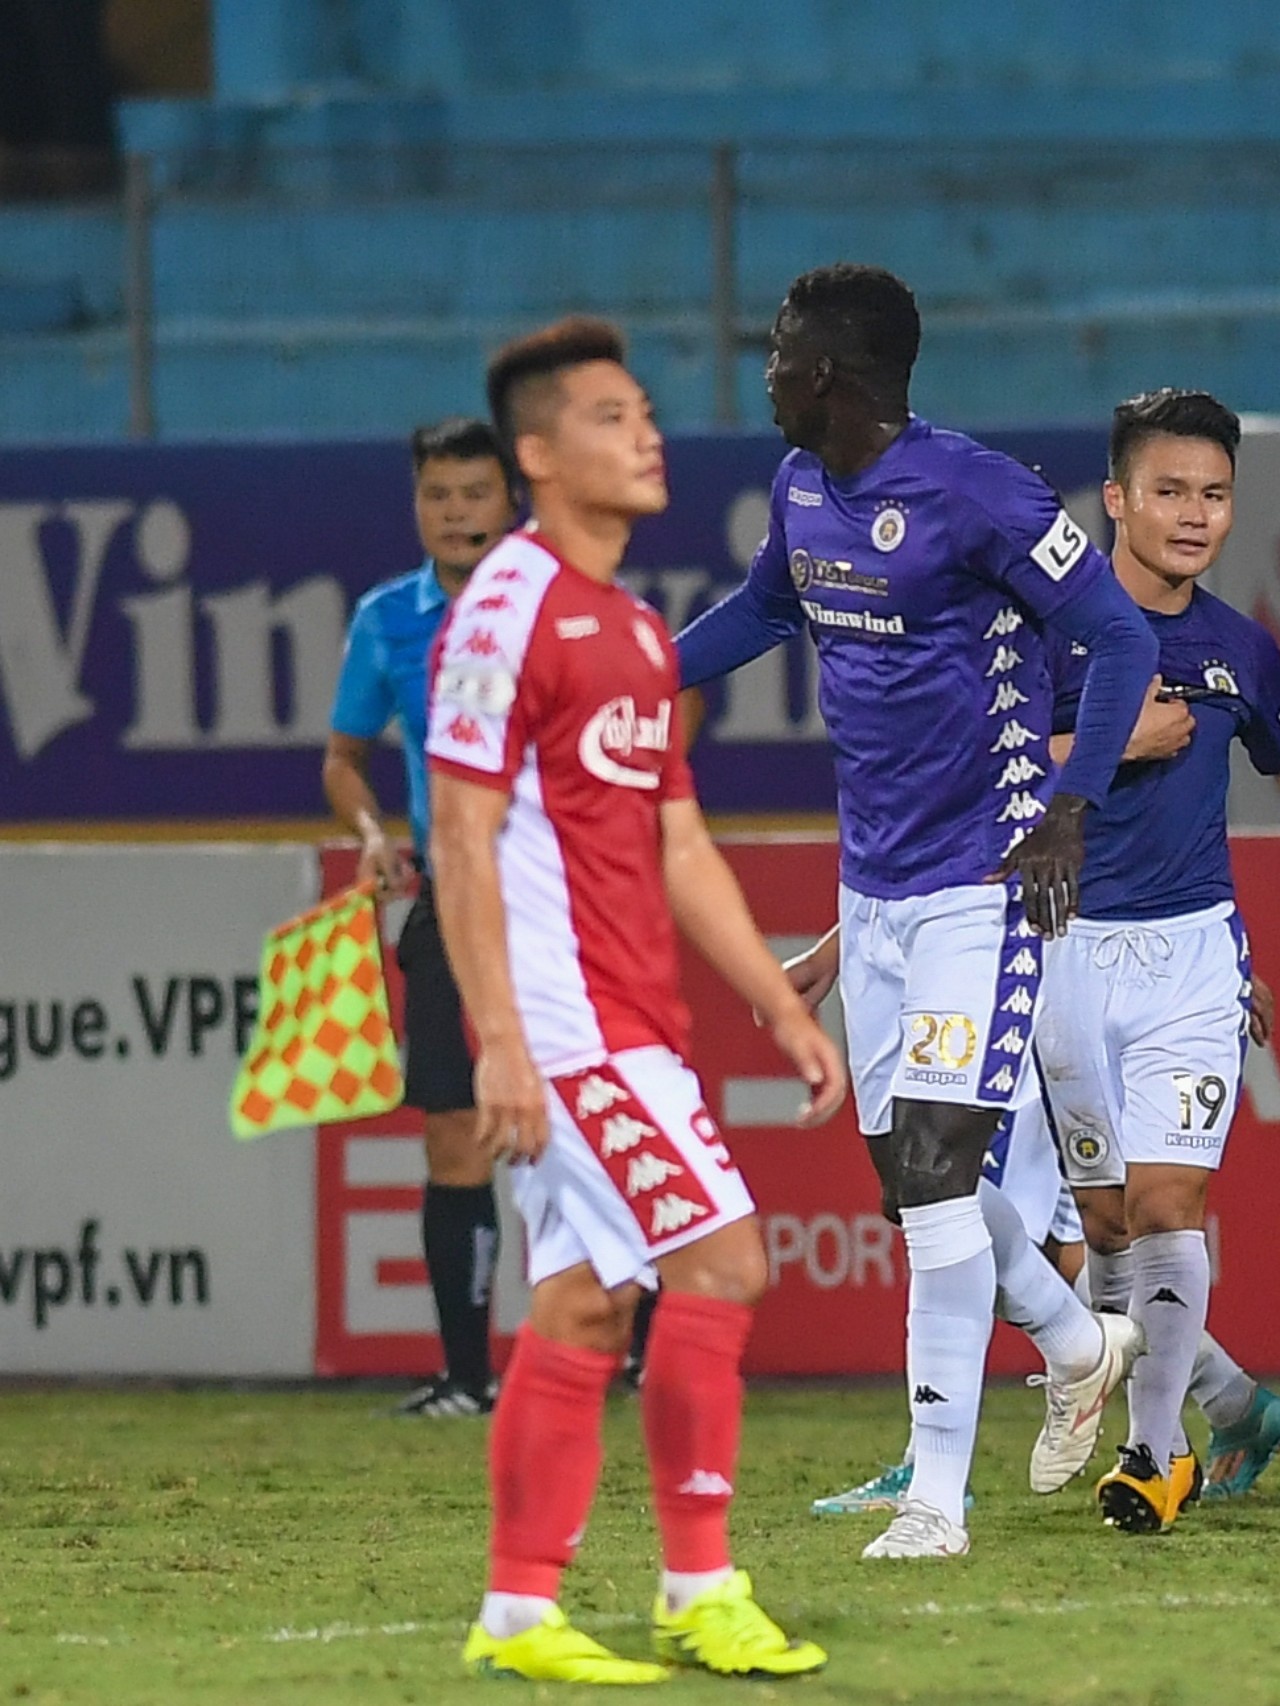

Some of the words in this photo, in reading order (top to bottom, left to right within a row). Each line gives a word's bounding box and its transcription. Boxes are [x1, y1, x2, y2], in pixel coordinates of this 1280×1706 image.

[1048, 523, 1081, 568] LS
[800, 599, 906, 635] Vinawind
[906, 1013, 978, 1070] 20
[904, 1067, 967, 1086] Kappa
[1172, 1074, 1227, 1131] 19
[1165, 1132, 1222, 1149] Kappa
[766, 1213, 896, 1289] POR
